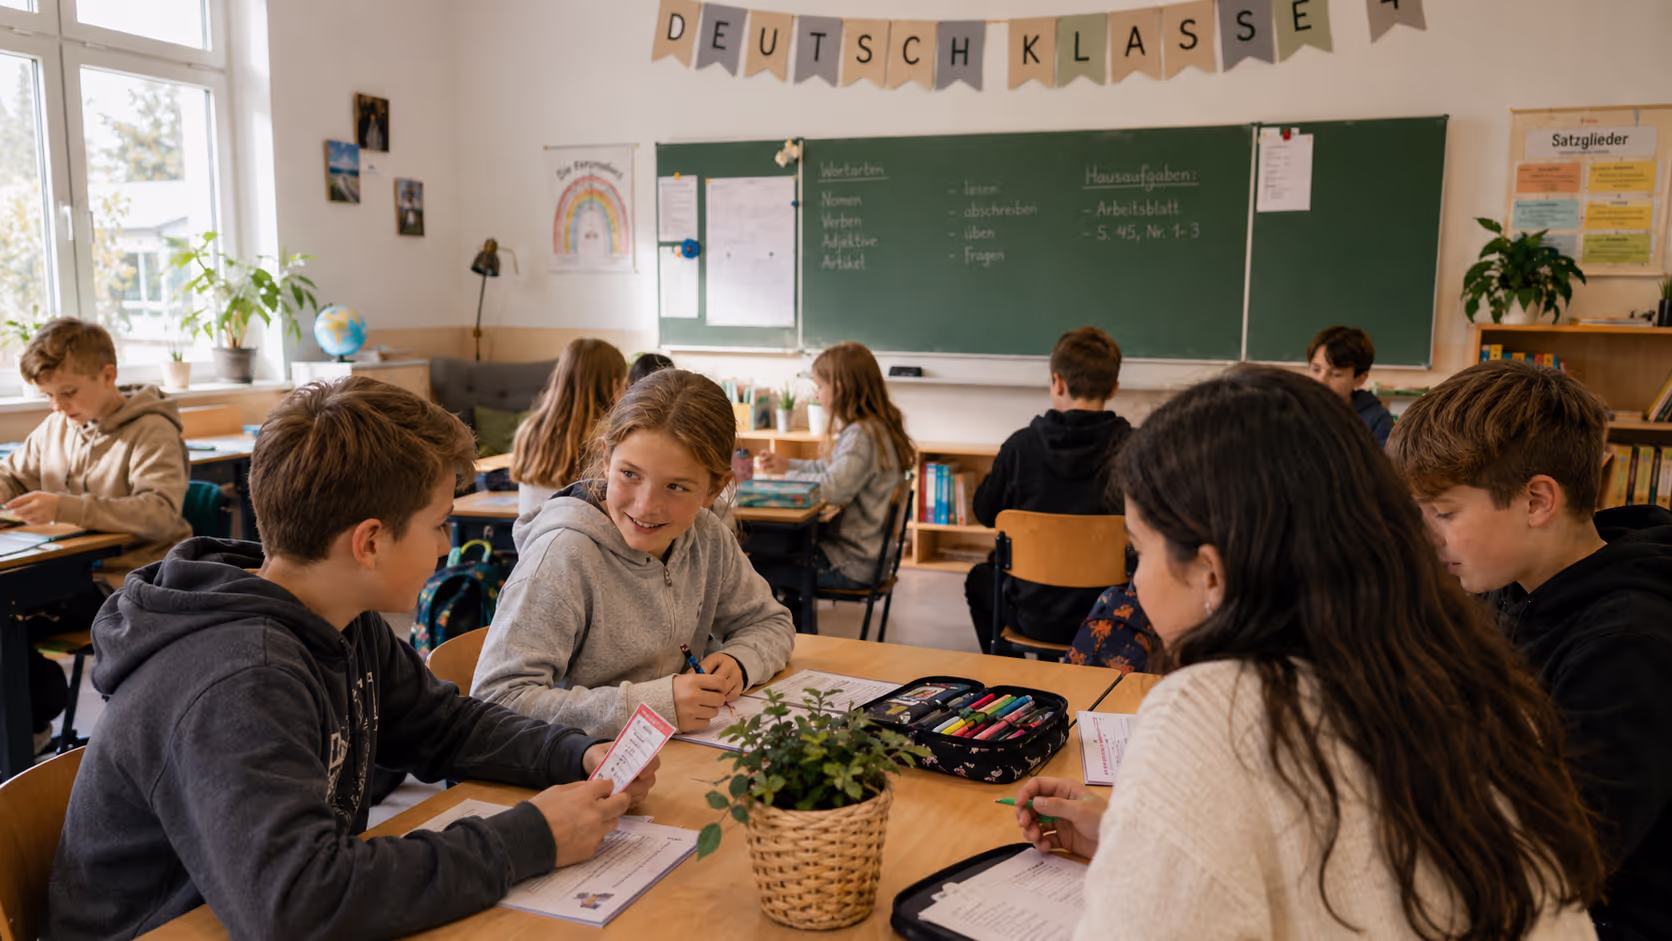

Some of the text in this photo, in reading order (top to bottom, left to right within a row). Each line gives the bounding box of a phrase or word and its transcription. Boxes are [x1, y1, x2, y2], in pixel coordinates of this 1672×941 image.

[667, 0, 1313, 67] DEUTSCH KLASSE
[1551, 131, 1629, 150] Satzglieder
[819, 160, 885, 177] Wortarten
[1085, 163, 1200, 192] Hausaufgaben:
[820, 191, 863, 207] Nomen
[963, 199, 1038, 218] abschreiben
[1096, 199, 1181, 218] Arbeitsblatt
[820, 211, 863, 229] Verben
[963, 225, 995, 240] üben
[1116, 224, 1141, 244] 45,
[1146, 223, 1166, 239] Nr.
[820, 232, 878, 255] Adjektive
